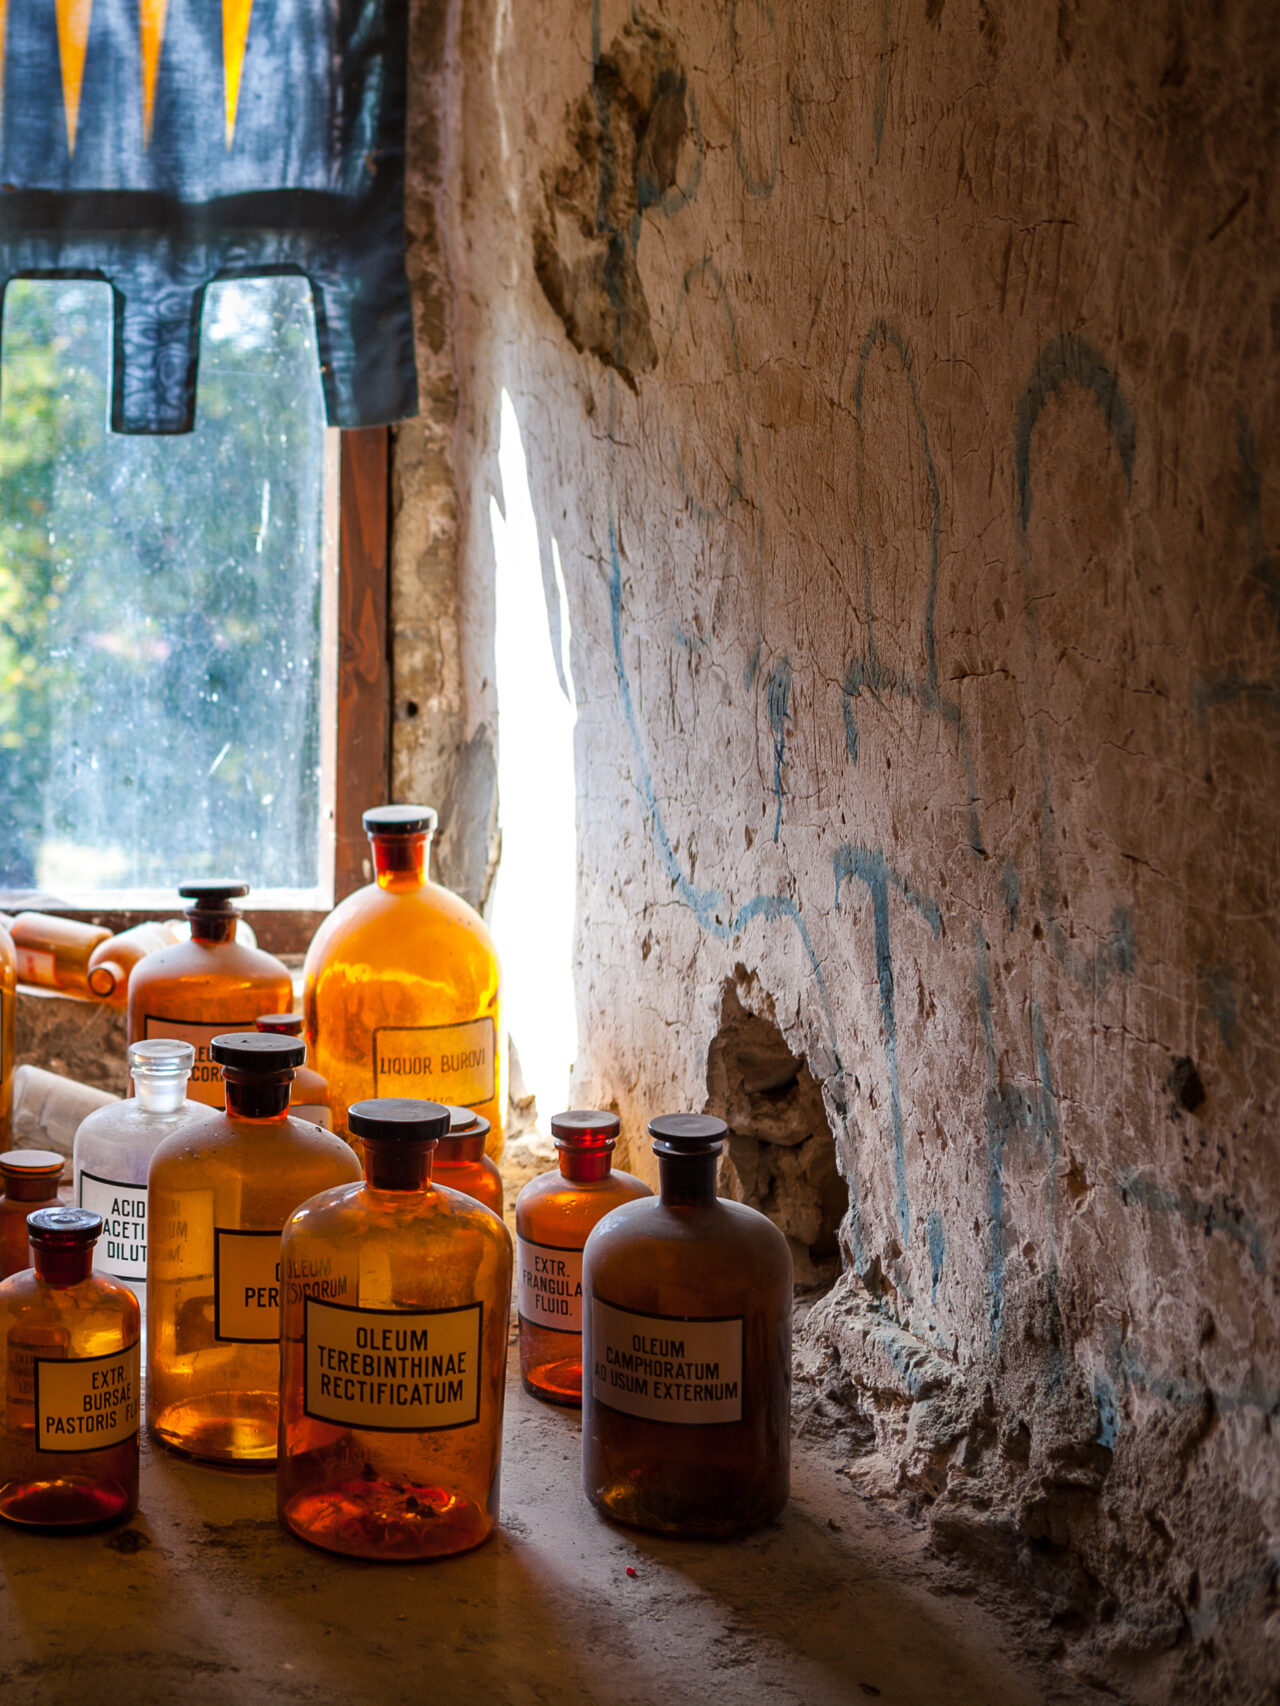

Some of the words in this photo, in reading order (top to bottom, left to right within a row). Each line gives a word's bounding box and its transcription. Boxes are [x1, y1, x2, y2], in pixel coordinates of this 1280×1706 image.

[380, 1056, 432, 1076] LIQUOR
[441, 1048, 485, 1073] BUROVI
[535, 1255, 570, 1278] EXTR.
[535, 1294, 573, 1316] FLUID.
[356, 1327, 428, 1351] OLEUM
[632, 1334, 685, 1358] OLEUM
[317, 1345, 467, 1379] TEREBINTHINAE
[606, 1346, 720, 1380] CAMPHORATUM
[91, 1365, 127, 1390] EXTR.
[320, 1373, 464, 1406] RECTIFICATUM
[594, 1360, 607, 1381] AD
[610, 1369, 648, 1397] USUM
[653, 1381, 738, 1402] EXTERNUM
[83, 1383, 132, 1412] BURSAE
[46, 1411, 117, 1434] PASTORIS
